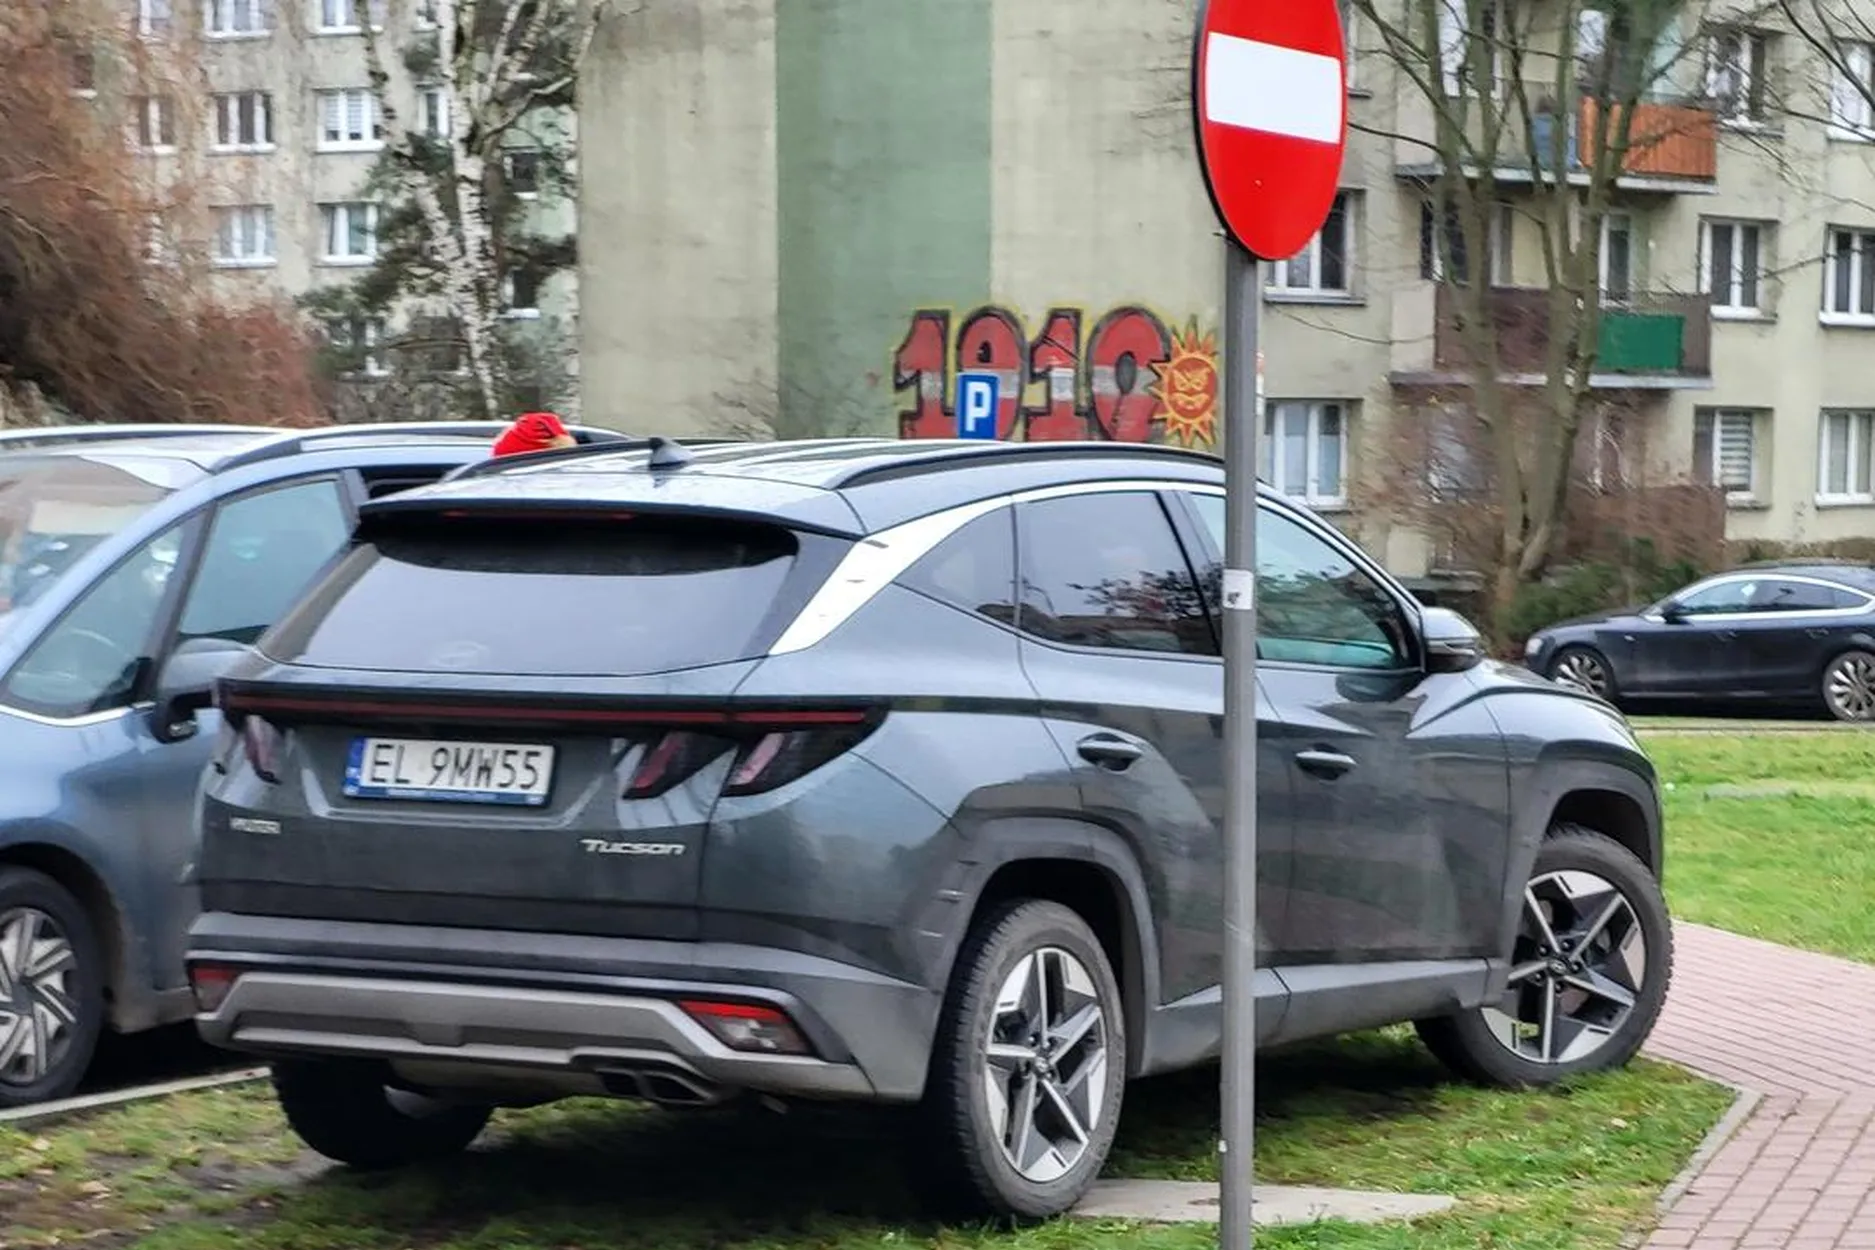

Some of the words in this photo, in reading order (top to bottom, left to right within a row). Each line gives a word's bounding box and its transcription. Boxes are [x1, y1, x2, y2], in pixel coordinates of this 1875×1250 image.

[965, 381, 991, 432] P
[371, 744, 410, 784] EL
[427, 747, 541, 790] 9MW55
[580, 838, 686, 856] Tucson
